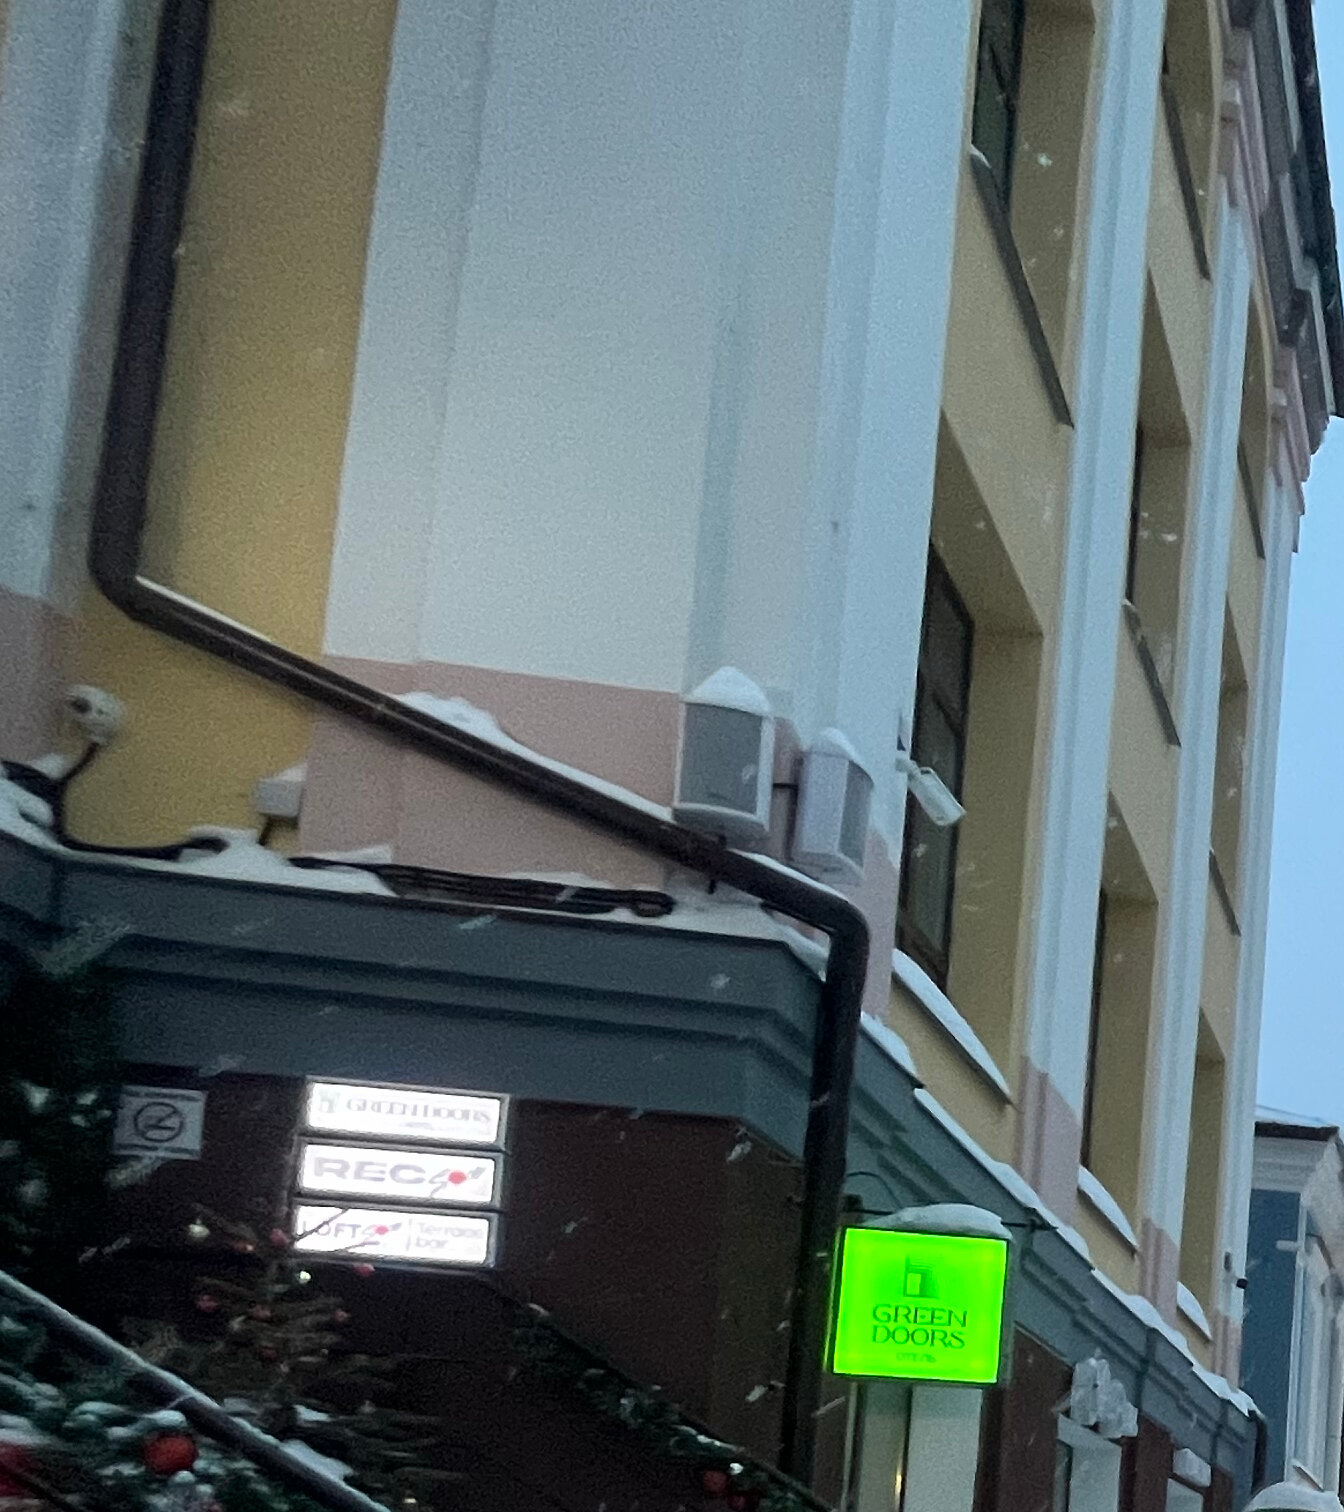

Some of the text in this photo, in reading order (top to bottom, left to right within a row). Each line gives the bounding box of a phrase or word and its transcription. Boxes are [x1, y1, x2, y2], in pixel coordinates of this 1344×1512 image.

[313, 1156, 426, 1185] REC
[872, 1303, 967, 1328] GREEN
[872, 1325, 966, 1349] DOORS
